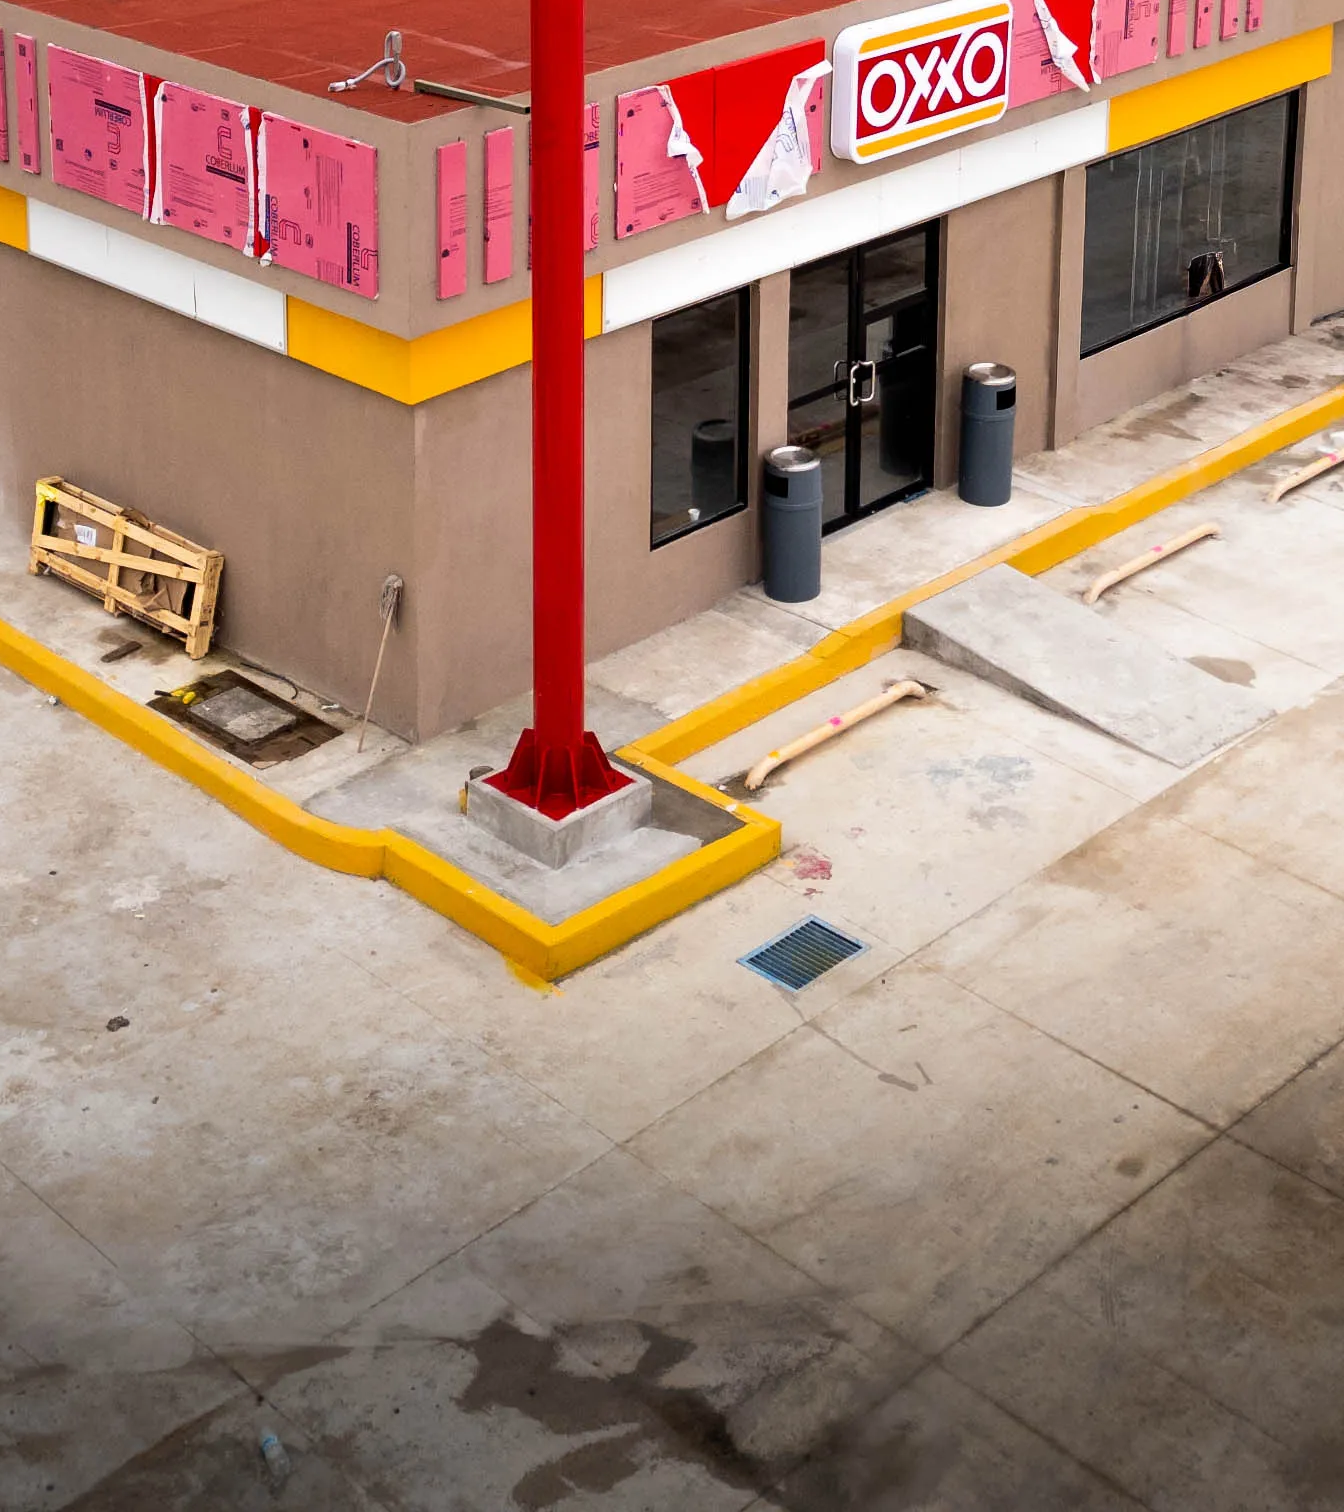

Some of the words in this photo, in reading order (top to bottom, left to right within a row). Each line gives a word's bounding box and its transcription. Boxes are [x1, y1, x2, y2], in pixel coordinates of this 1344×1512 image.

[860, 31, 1004, 129] OXXO
[206, 154, 246, 177] COBERLUM
[352, 224, 360, 287] COBERLUM
